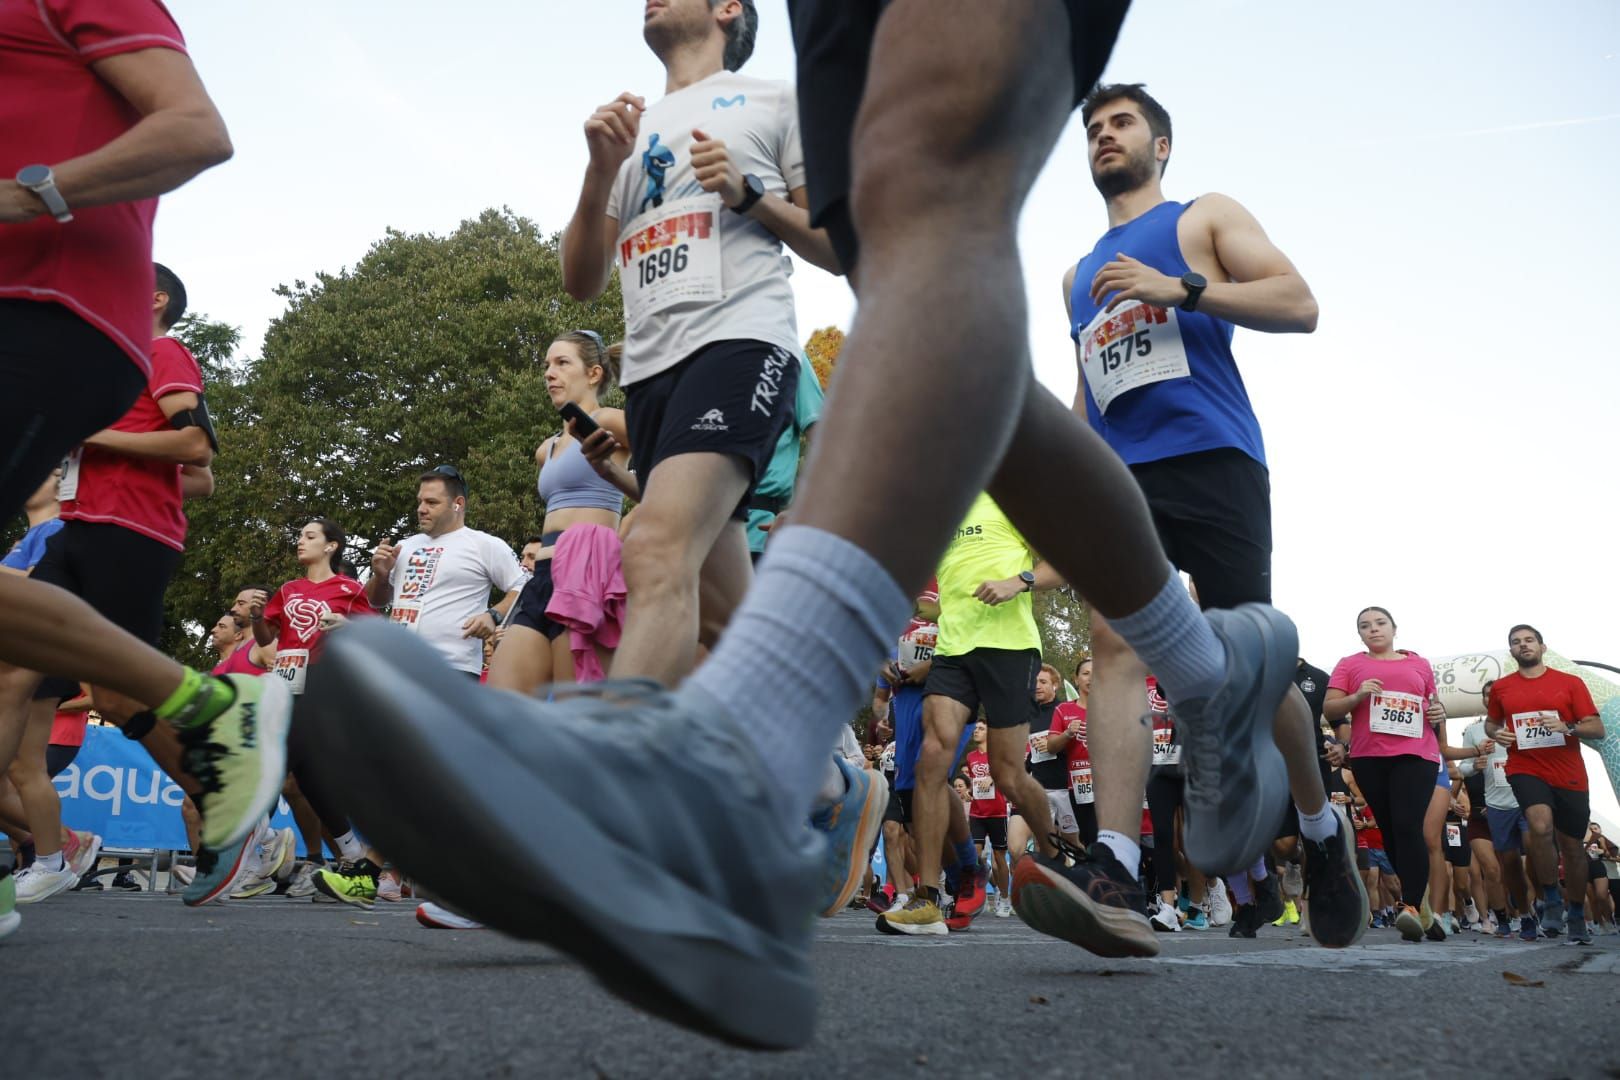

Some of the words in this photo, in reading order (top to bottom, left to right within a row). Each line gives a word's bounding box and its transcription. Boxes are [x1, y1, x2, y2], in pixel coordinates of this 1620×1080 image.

[638, 244, 689, 288] 1696
[1100, 329, 1152, 376] 1575
[913, 646, 933, 661] 115
[1381, 708, 1414, 724] 3663
[1153, 743, 1177, 754] 3472
